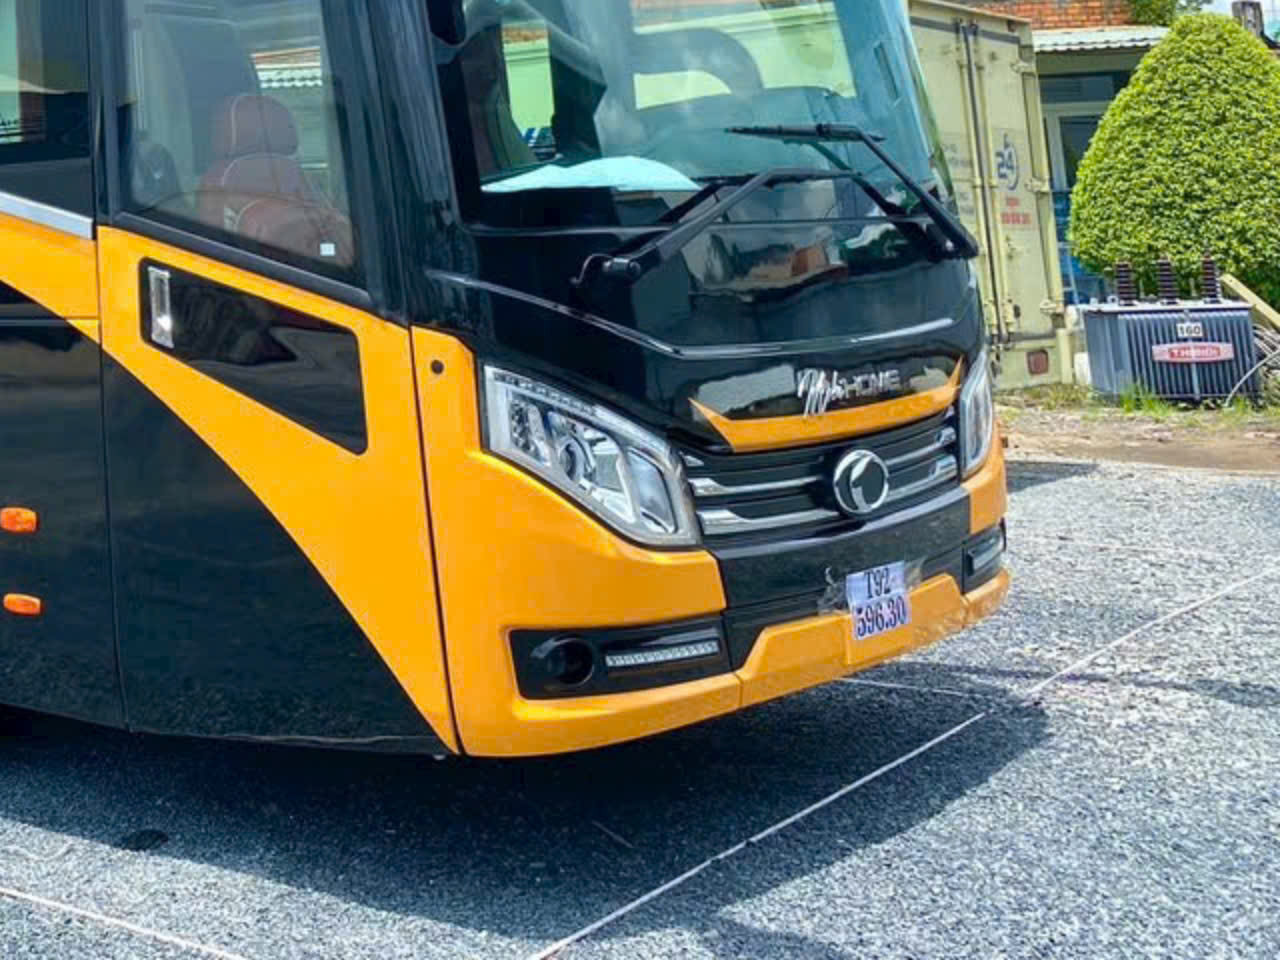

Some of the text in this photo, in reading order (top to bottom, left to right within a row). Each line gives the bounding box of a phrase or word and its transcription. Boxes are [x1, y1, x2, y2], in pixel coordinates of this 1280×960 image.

[1179, 325, 1202, 336] 160
[864, 567, 892, 598] T92
[856, 595, 907, 637] 596.30
